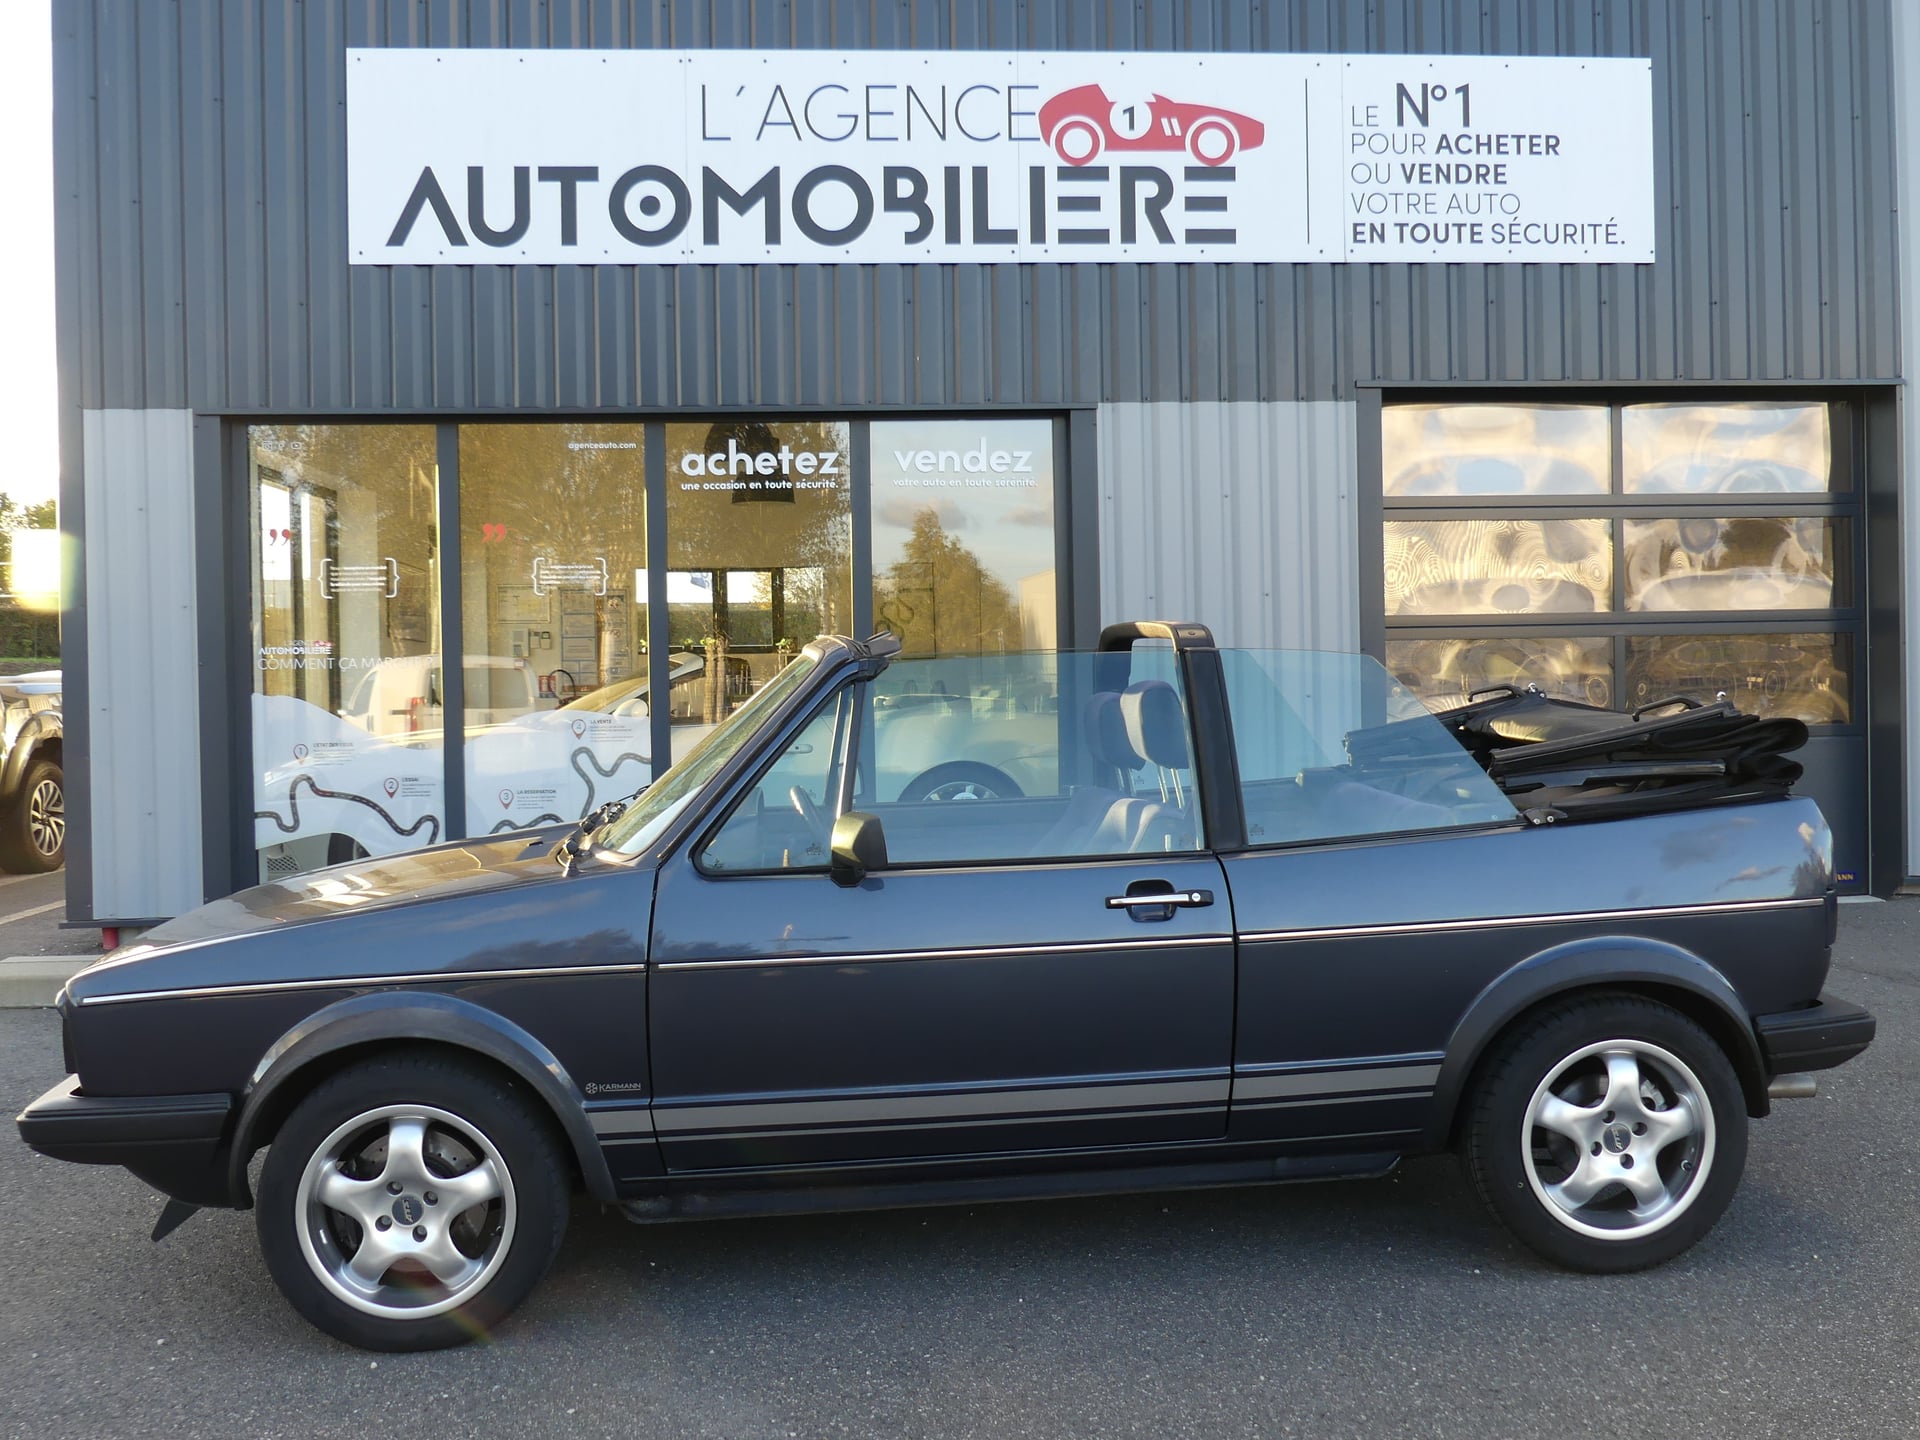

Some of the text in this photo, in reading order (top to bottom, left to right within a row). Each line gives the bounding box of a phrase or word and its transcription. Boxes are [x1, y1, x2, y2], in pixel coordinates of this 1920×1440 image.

[1123, 105, 1134, 131] 1
[1352, 105, 1379, 127] LE
[1352, 133, 1561, 155] POUR ACHETER
[1351, 162, 1508, 185] OU VENDRE
[1351, 192, 1521, 214] VOTRE AUTO
[1352, 216, 1626, 245] EN TOUTE SÉCURITÉ.
[568, 441, 637, 451] agenceauto.com
[681, 438, 839, 476] achetez
[894, 437, 1033, 473] vendez
[681, 482, 700, 490] une
[703, 480, 746, 490] occasion
[765, 480, 792, 489] toute
[795, 479, 839, 489] sécurité.
[893, 478, 919, 487] votre
[922, 478, 946, 487] auto
[949, 479, 961, 487] en
[965, 478, 992, 487] toute
[258, 658, 335, 670] COMMENT
[339, 657, 358, 672] ÇA
[600, 1083, 641, 1092] KARMANN
